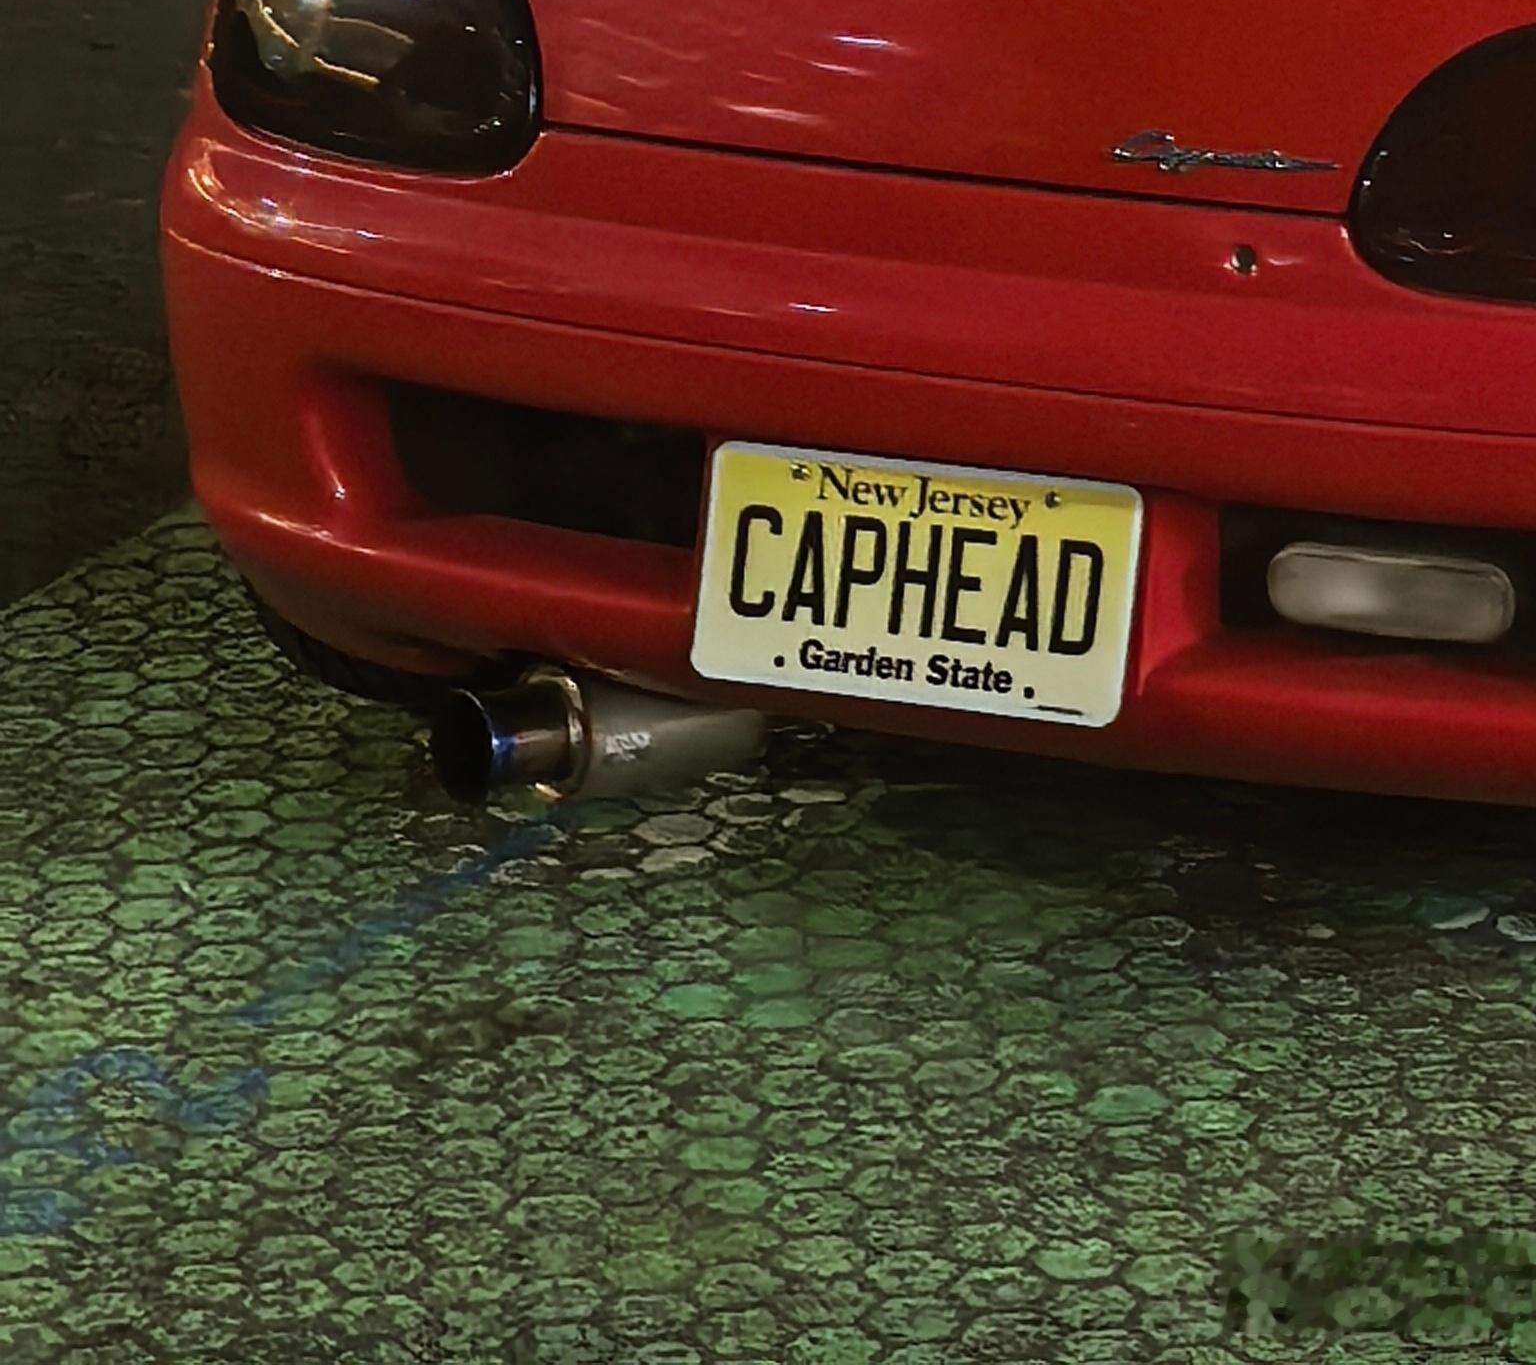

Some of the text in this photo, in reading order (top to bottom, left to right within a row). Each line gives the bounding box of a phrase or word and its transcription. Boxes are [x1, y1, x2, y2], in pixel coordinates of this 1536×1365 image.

[816, 465, 1032, 529] New Jersey
[729, 504, 1104, 656] CAPHEAD
[799, 638, 1013, 696] Garden State
